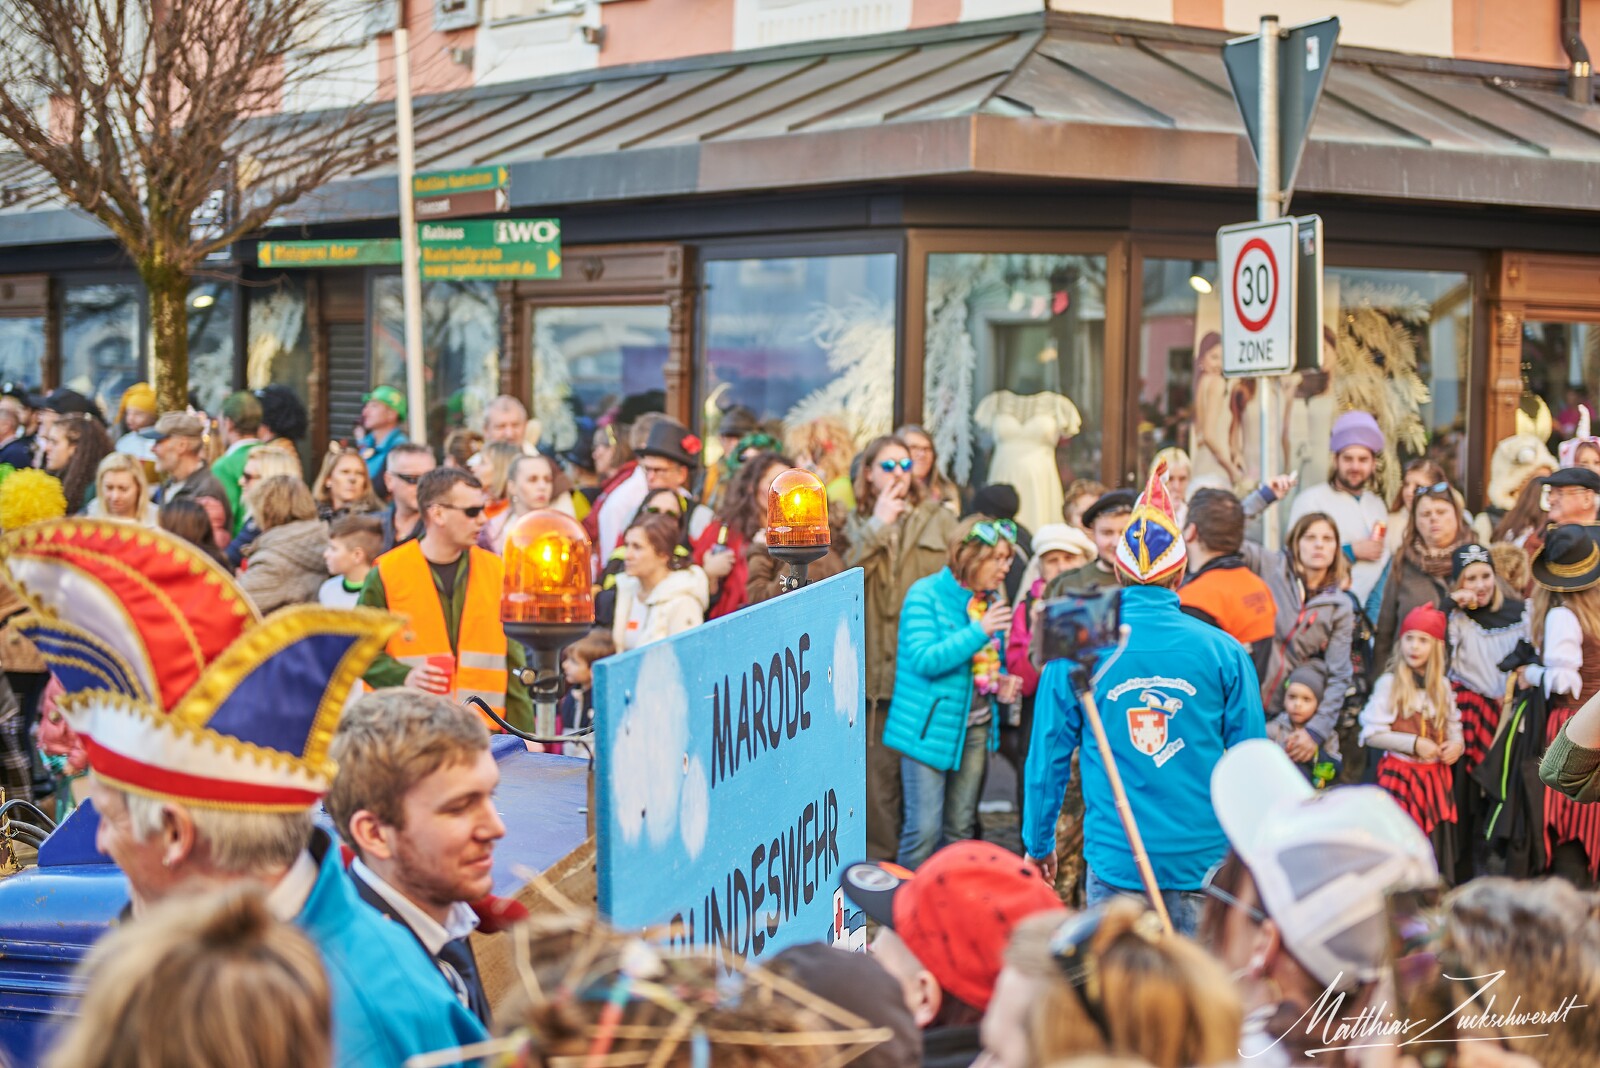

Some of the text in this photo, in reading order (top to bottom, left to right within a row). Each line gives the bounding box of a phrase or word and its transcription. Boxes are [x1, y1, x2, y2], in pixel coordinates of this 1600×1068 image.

[421, 225, 465, 241] Rathaus
[1242, 263, 1269, 306] 30
[1238, 338, 1274, 363] ZONE
[711, 632, 811, 790] MARODE
